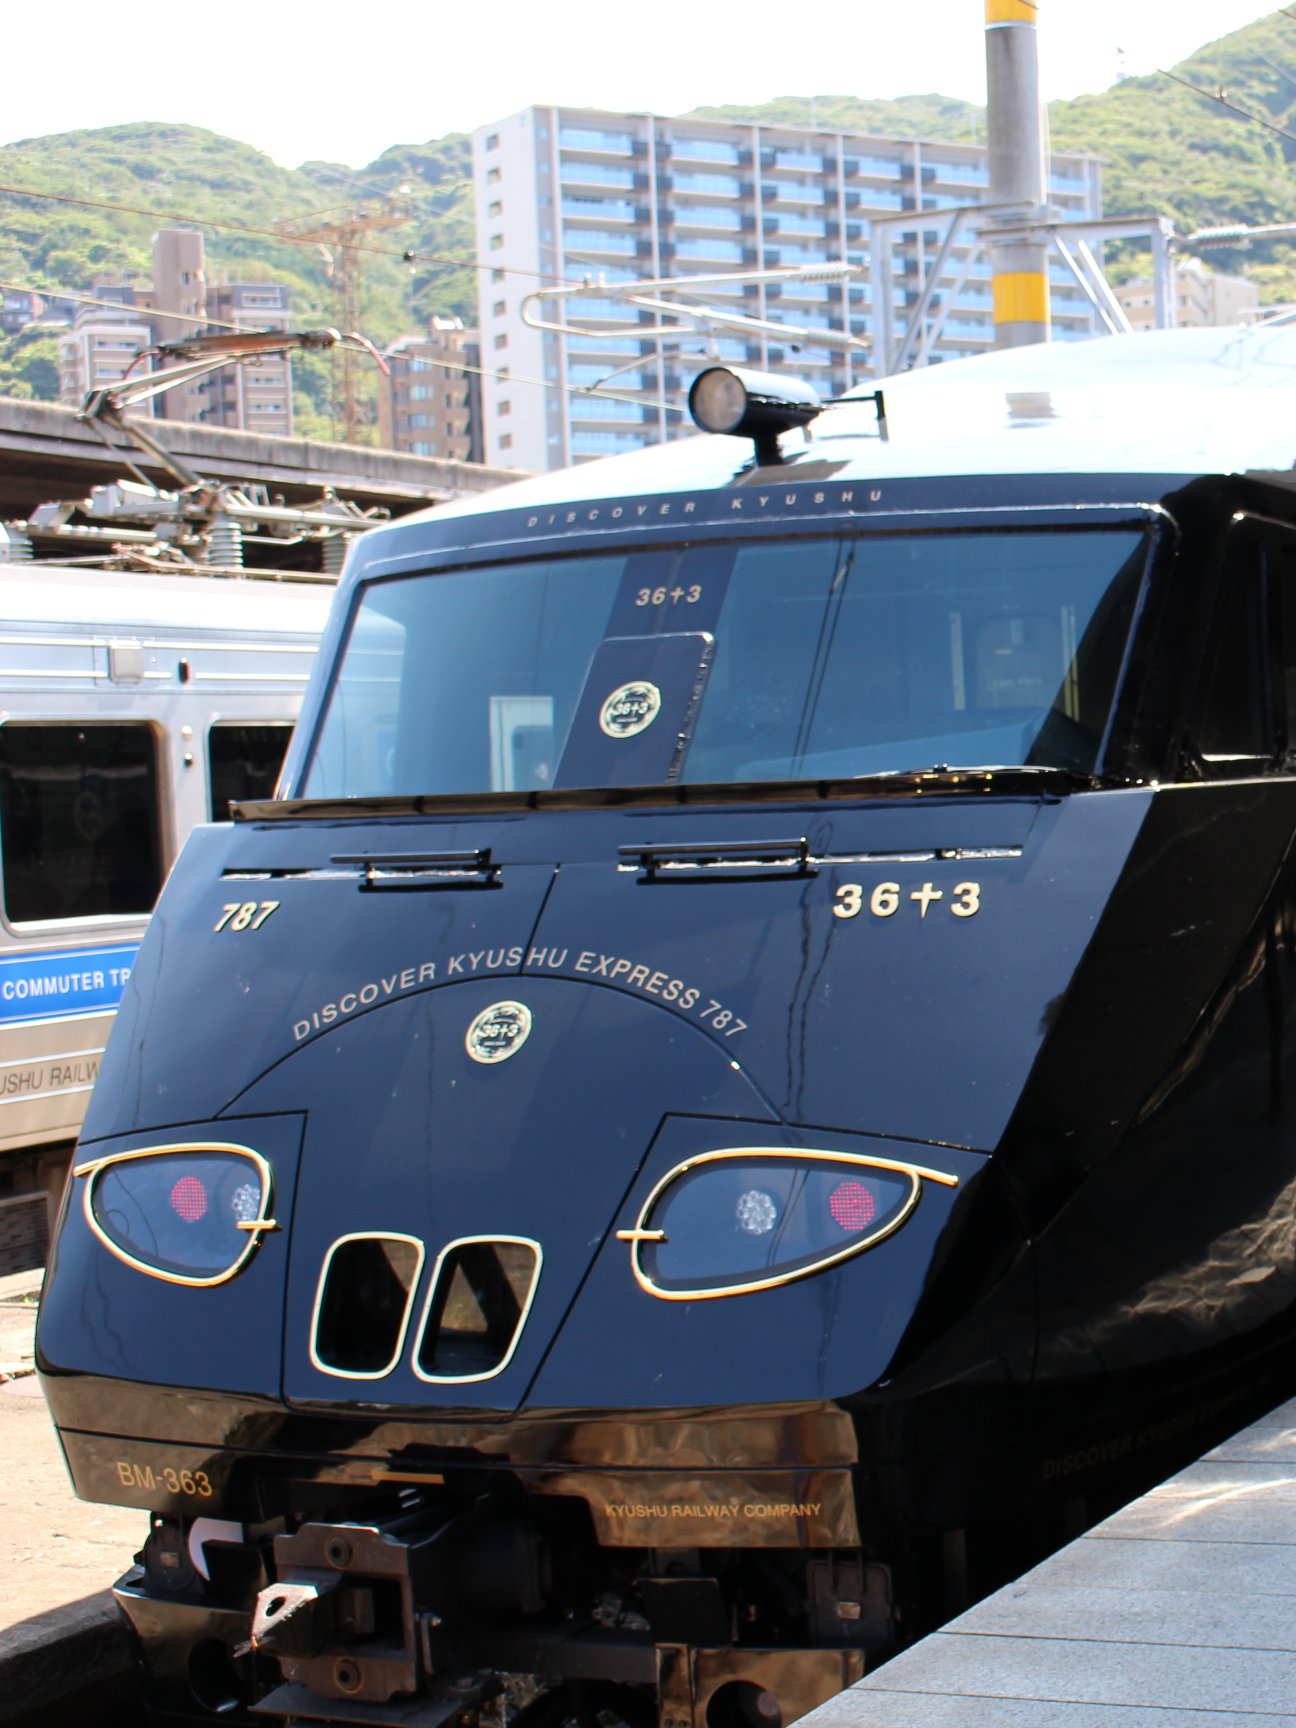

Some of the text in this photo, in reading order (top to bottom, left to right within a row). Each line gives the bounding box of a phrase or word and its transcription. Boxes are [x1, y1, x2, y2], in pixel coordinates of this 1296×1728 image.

[527, 490, 882, 528] DISCOVER KYUSHU
[213, 901, 281, 932] 787
[2, 970, 105, 1000] COMMUTER
[293, 947, 748, 1041] DISCOVER KYUSHU EXPRESS 787
[1042, 1435, 1132, 1479] DISCOVER
[116, 1461, 213, 1497] BM-363
[604, 1503, 822, 1517] KYUSHU RAILWAY COMPANY
